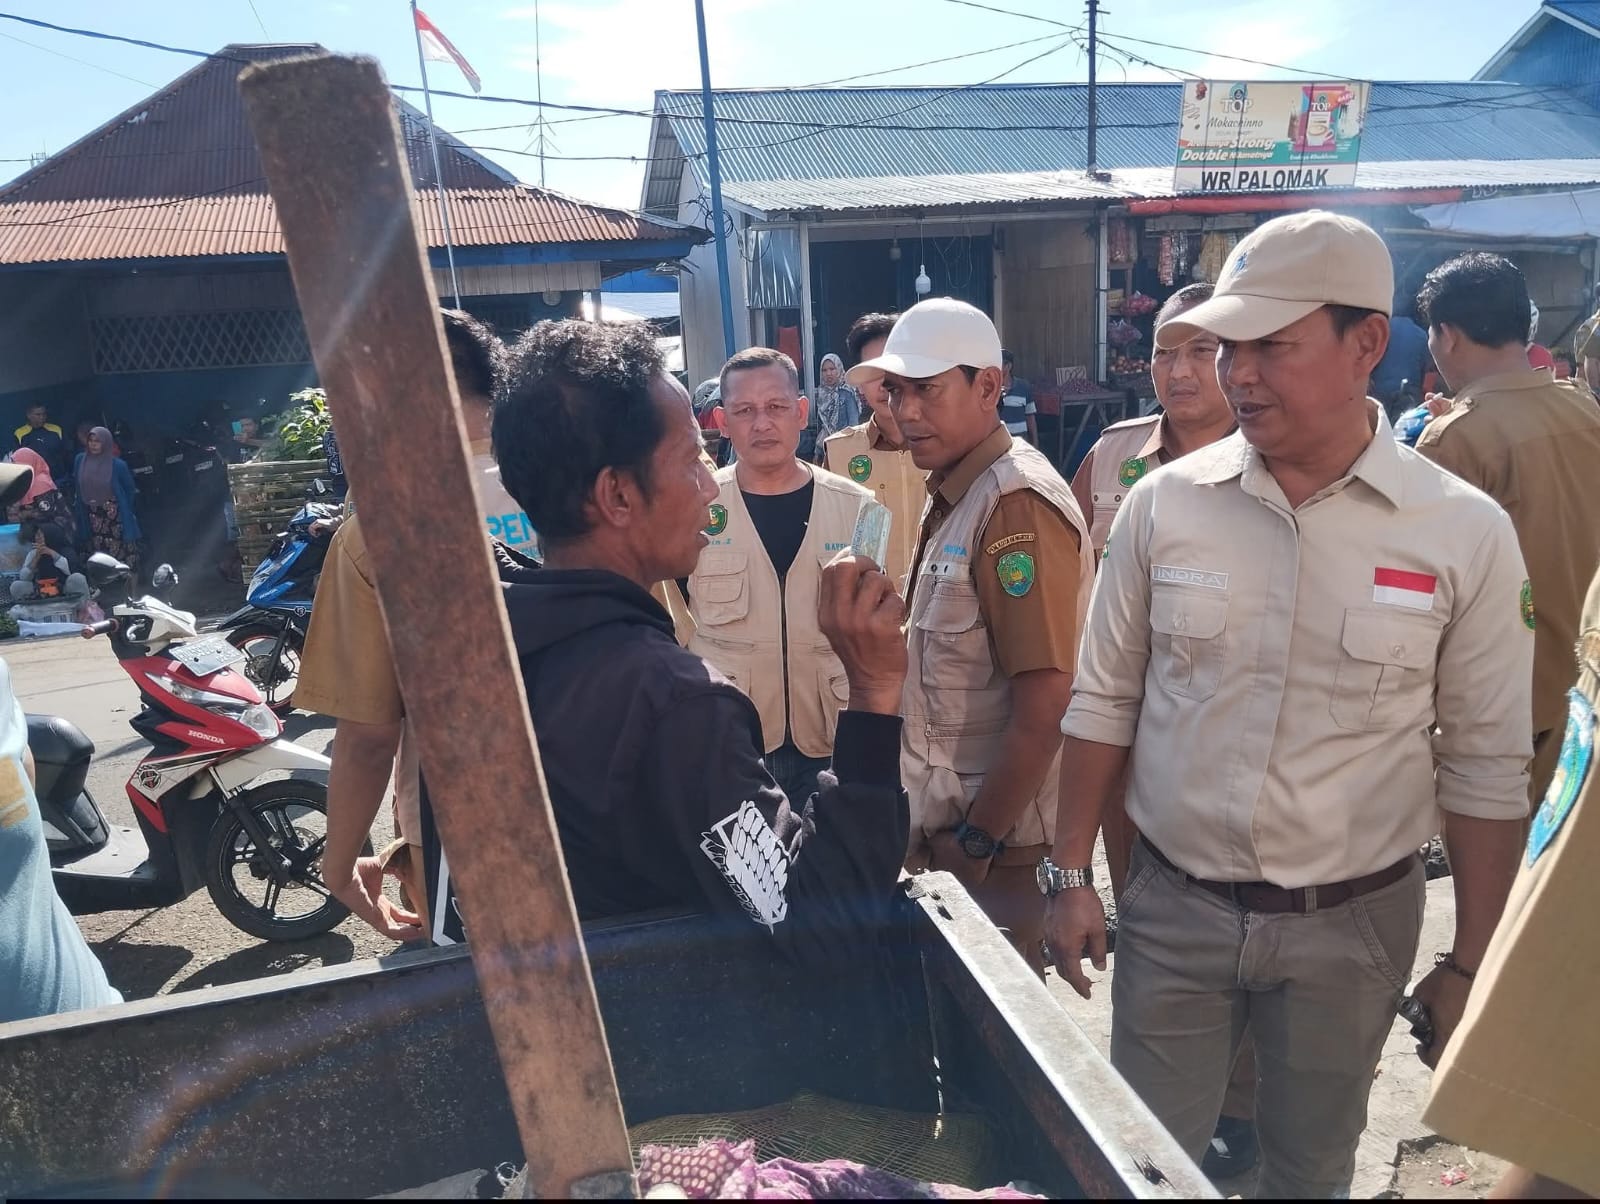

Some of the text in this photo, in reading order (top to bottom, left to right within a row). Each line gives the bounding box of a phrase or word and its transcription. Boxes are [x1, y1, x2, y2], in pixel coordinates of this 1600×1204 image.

[1220, 98, 1254, 113] TOP
[1311, 102, 1331, 112] TOP
[1229, 136, 1276, 151] Strong,
[1181, 149, 1229, 161] Double
[1201, 169, 1329, 190] WR PALOMAK
[1157, 568, 1222, 586] INDRA
[187, 729, 226, 745] HONDA
